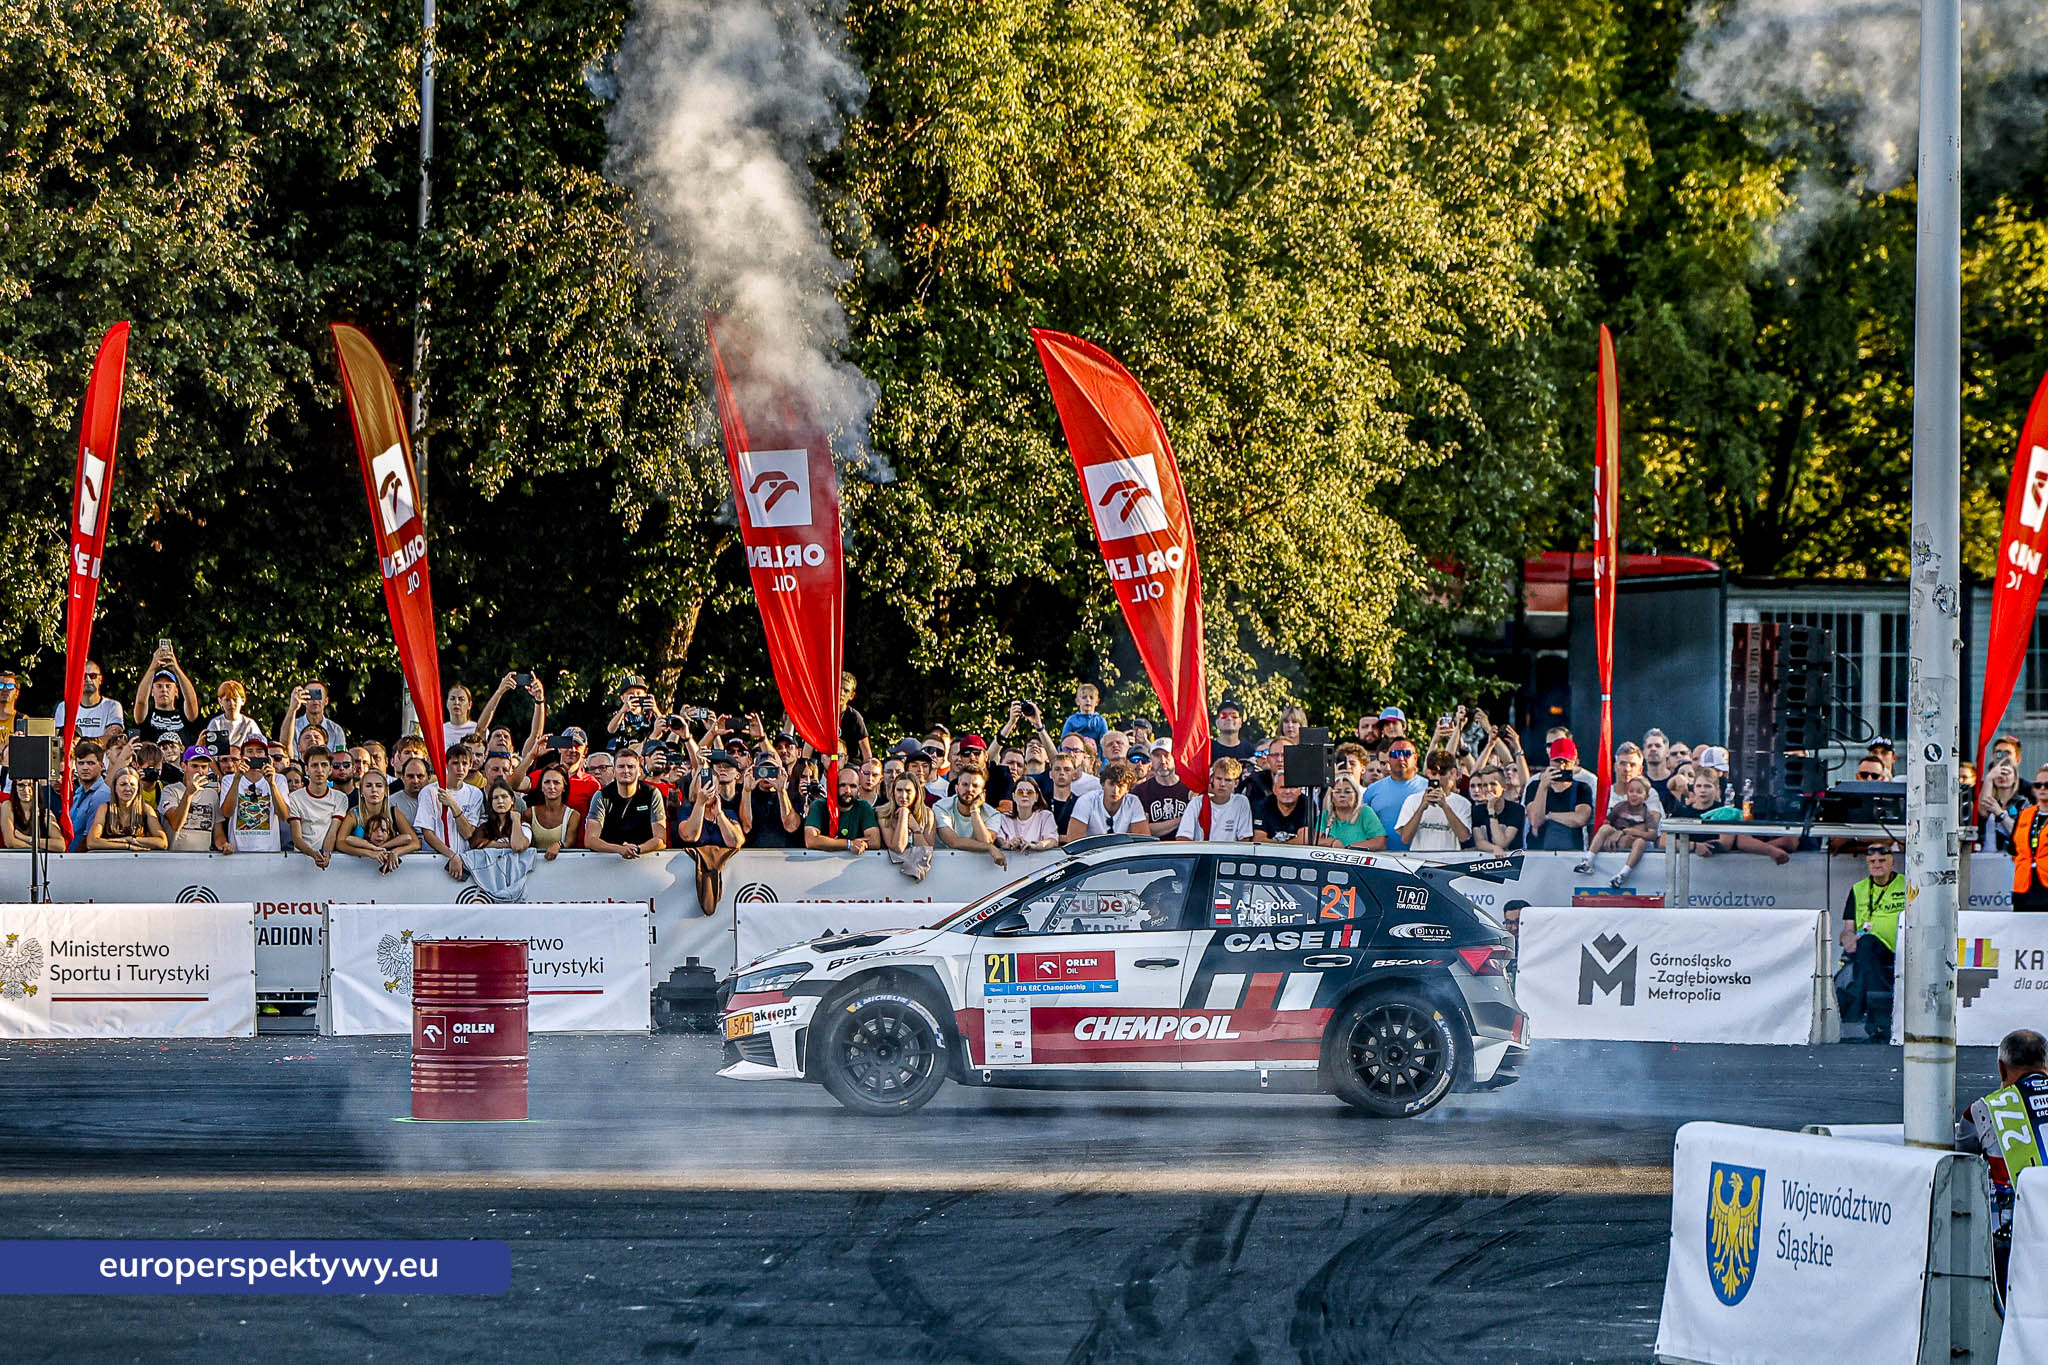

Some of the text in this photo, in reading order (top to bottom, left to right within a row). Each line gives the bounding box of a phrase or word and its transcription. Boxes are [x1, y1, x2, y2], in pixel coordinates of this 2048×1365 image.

[1310, 851, 1358, 863] CASE
[1255, 899, 1297, 912] Sroka
[1320, 884, 1357, 919] 21
[1254, 913, 1296, 925] Kielar
[255, 926, 313, 946] ADION
[1224, 930, 1326, 953] CASE
[50, 940, 170, 958] Ministerstwo
[987, 954, 1011, 983] 21
[1065, 958, 1098, 967] ORLEN
[1650, 952, 1732, 971] Górnośląsko
[50, 964, 210, 984] Sportu i Turystyki
[1029, 984, 1041, 992] ERC
[1043, 984, 1087, 992] Championship
[2014, 976, 2032, 990] dla
[863, 994, 909, 1005] MICHELIN
[1649, 987, 1721, 1003] Metropolia
[452, 1022, 495, 1034] ORLEN
[452, 1035, 469, 1045] OIL
[1781, 1179, 1892, 1226] Województwo
[1776, 1221, 1834, 1271] Śląskie
